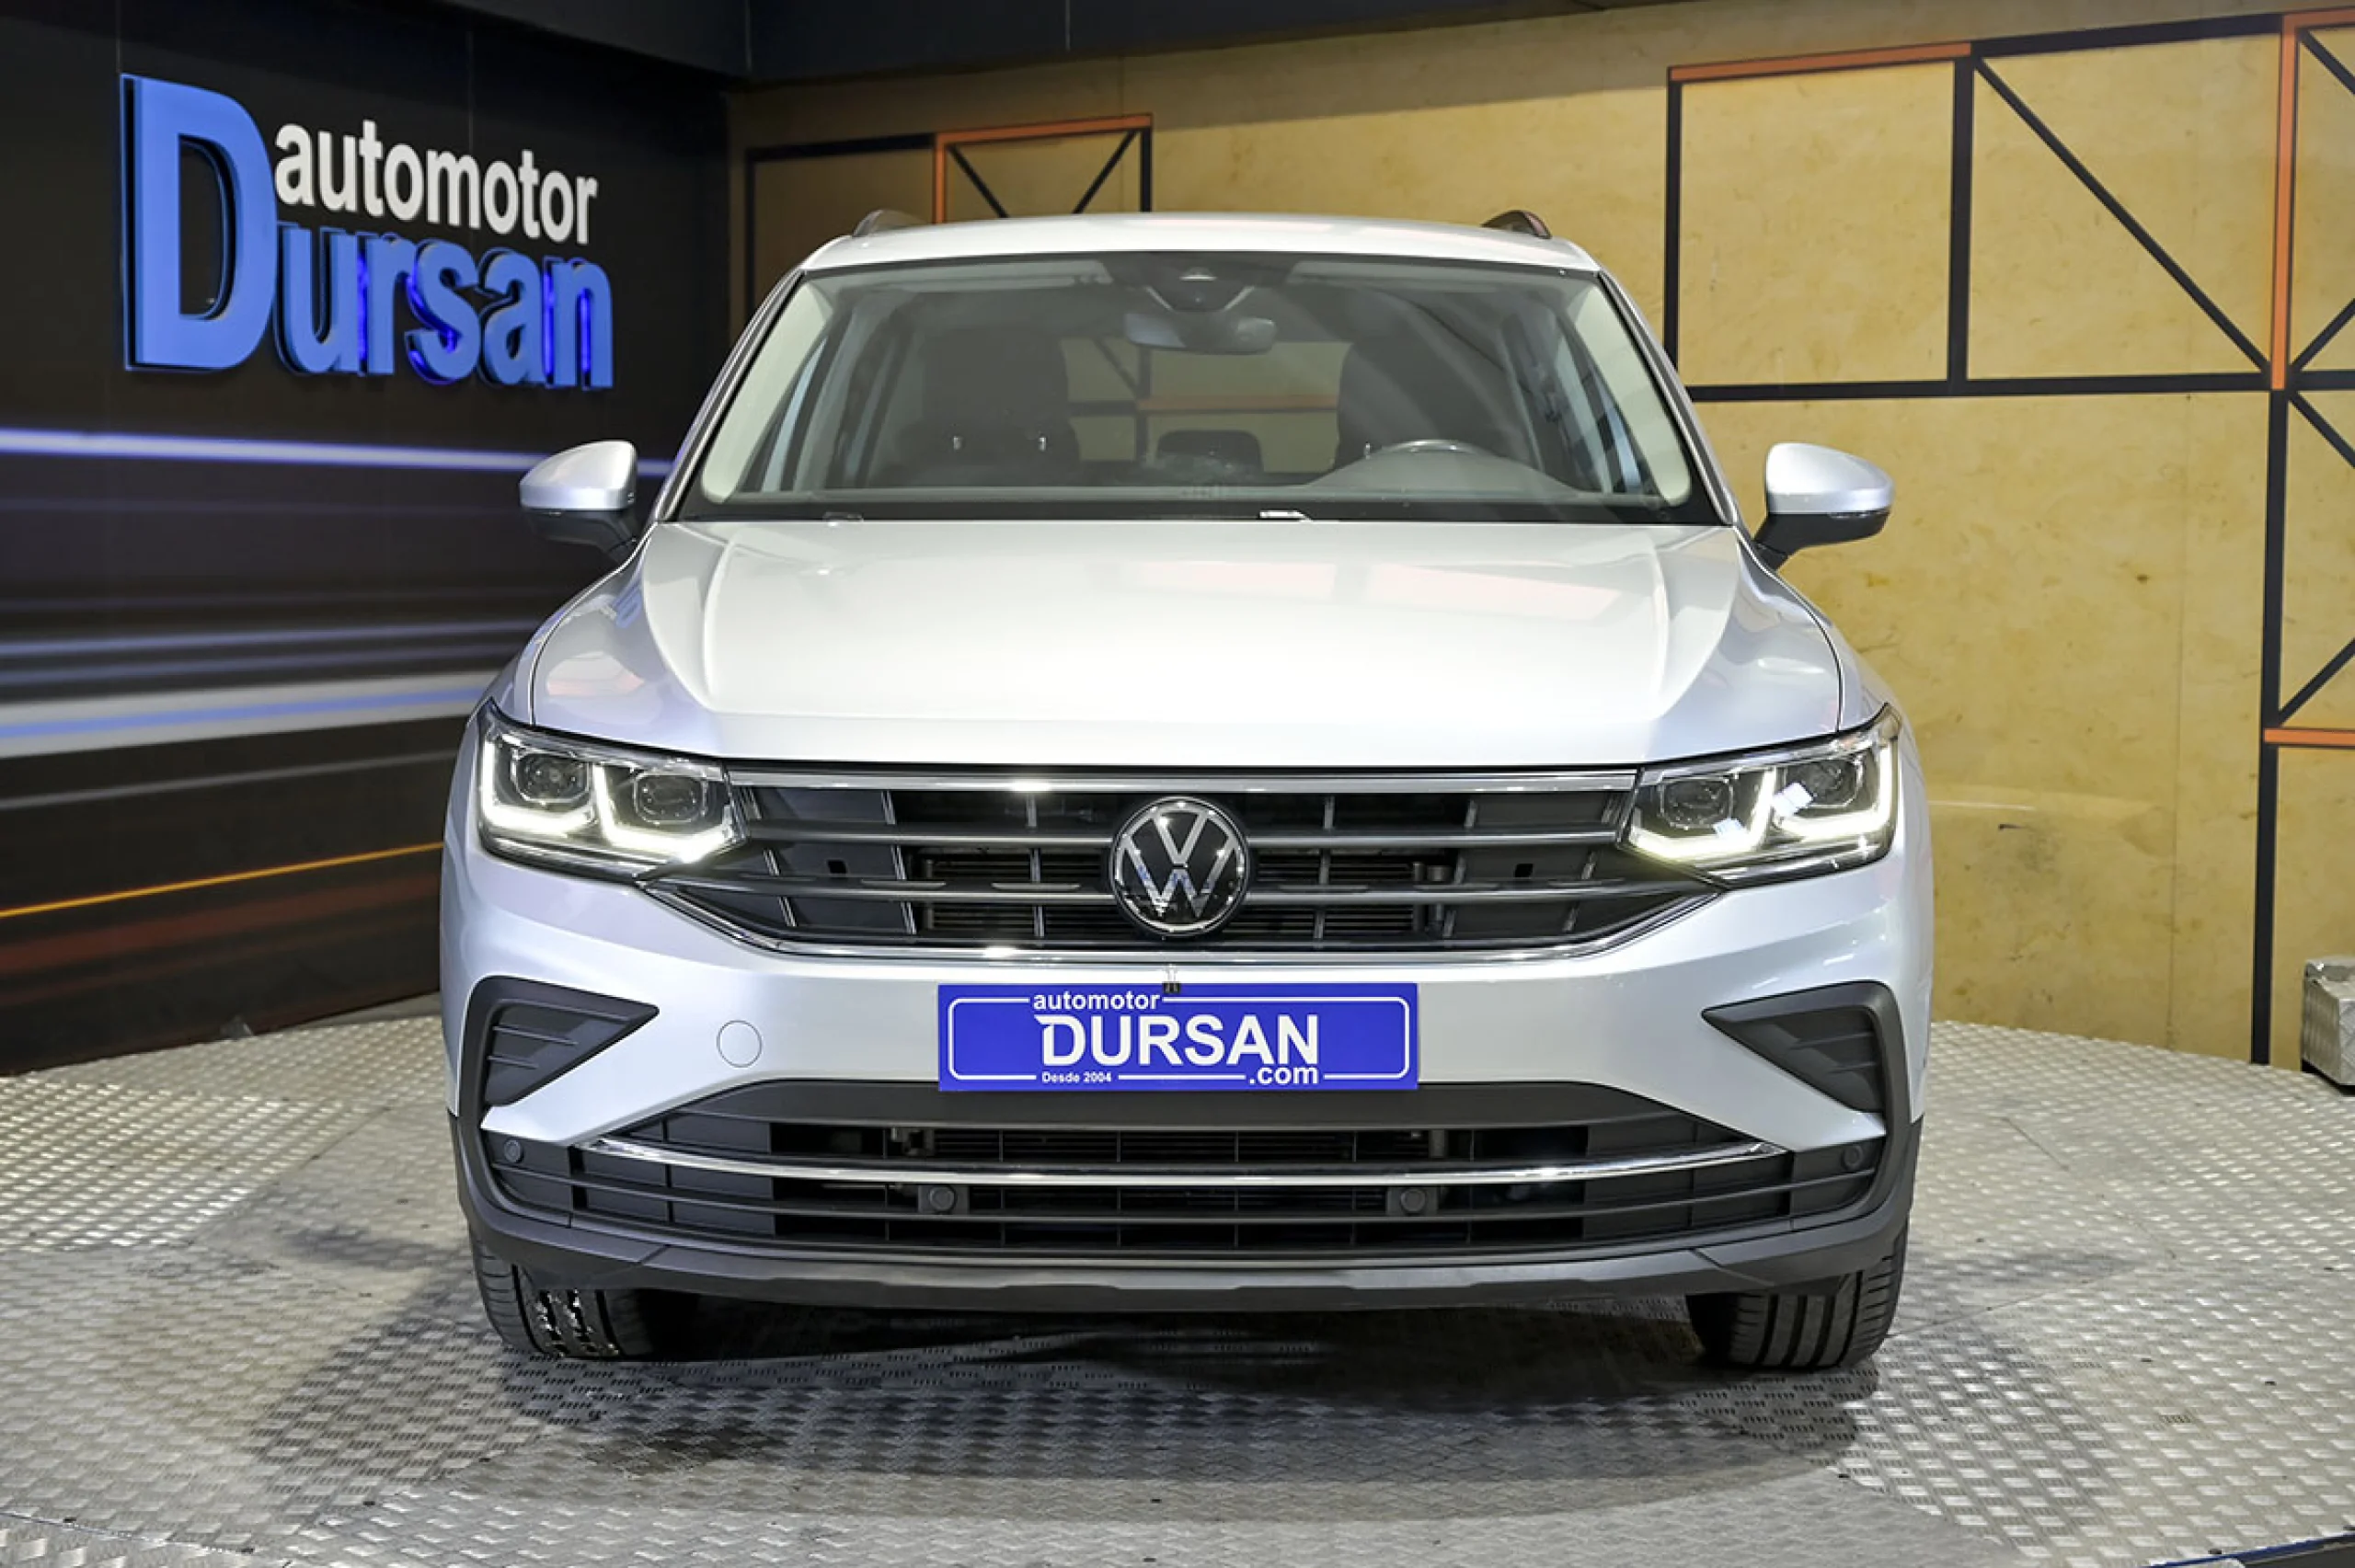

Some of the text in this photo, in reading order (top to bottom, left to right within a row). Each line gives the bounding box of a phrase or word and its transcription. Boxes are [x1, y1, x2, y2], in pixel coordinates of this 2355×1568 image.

[275, 120, 598, 245] automotor
[121, 73, 614, 390] Dursan
[1033, 990, 1161, 1010] automotor
[1034, 1014, 1318, 1066] DURSAN
[1041, 1071, 1111, 1083] Desde 2004
[1249, 1067, 1318, 1085] .com
